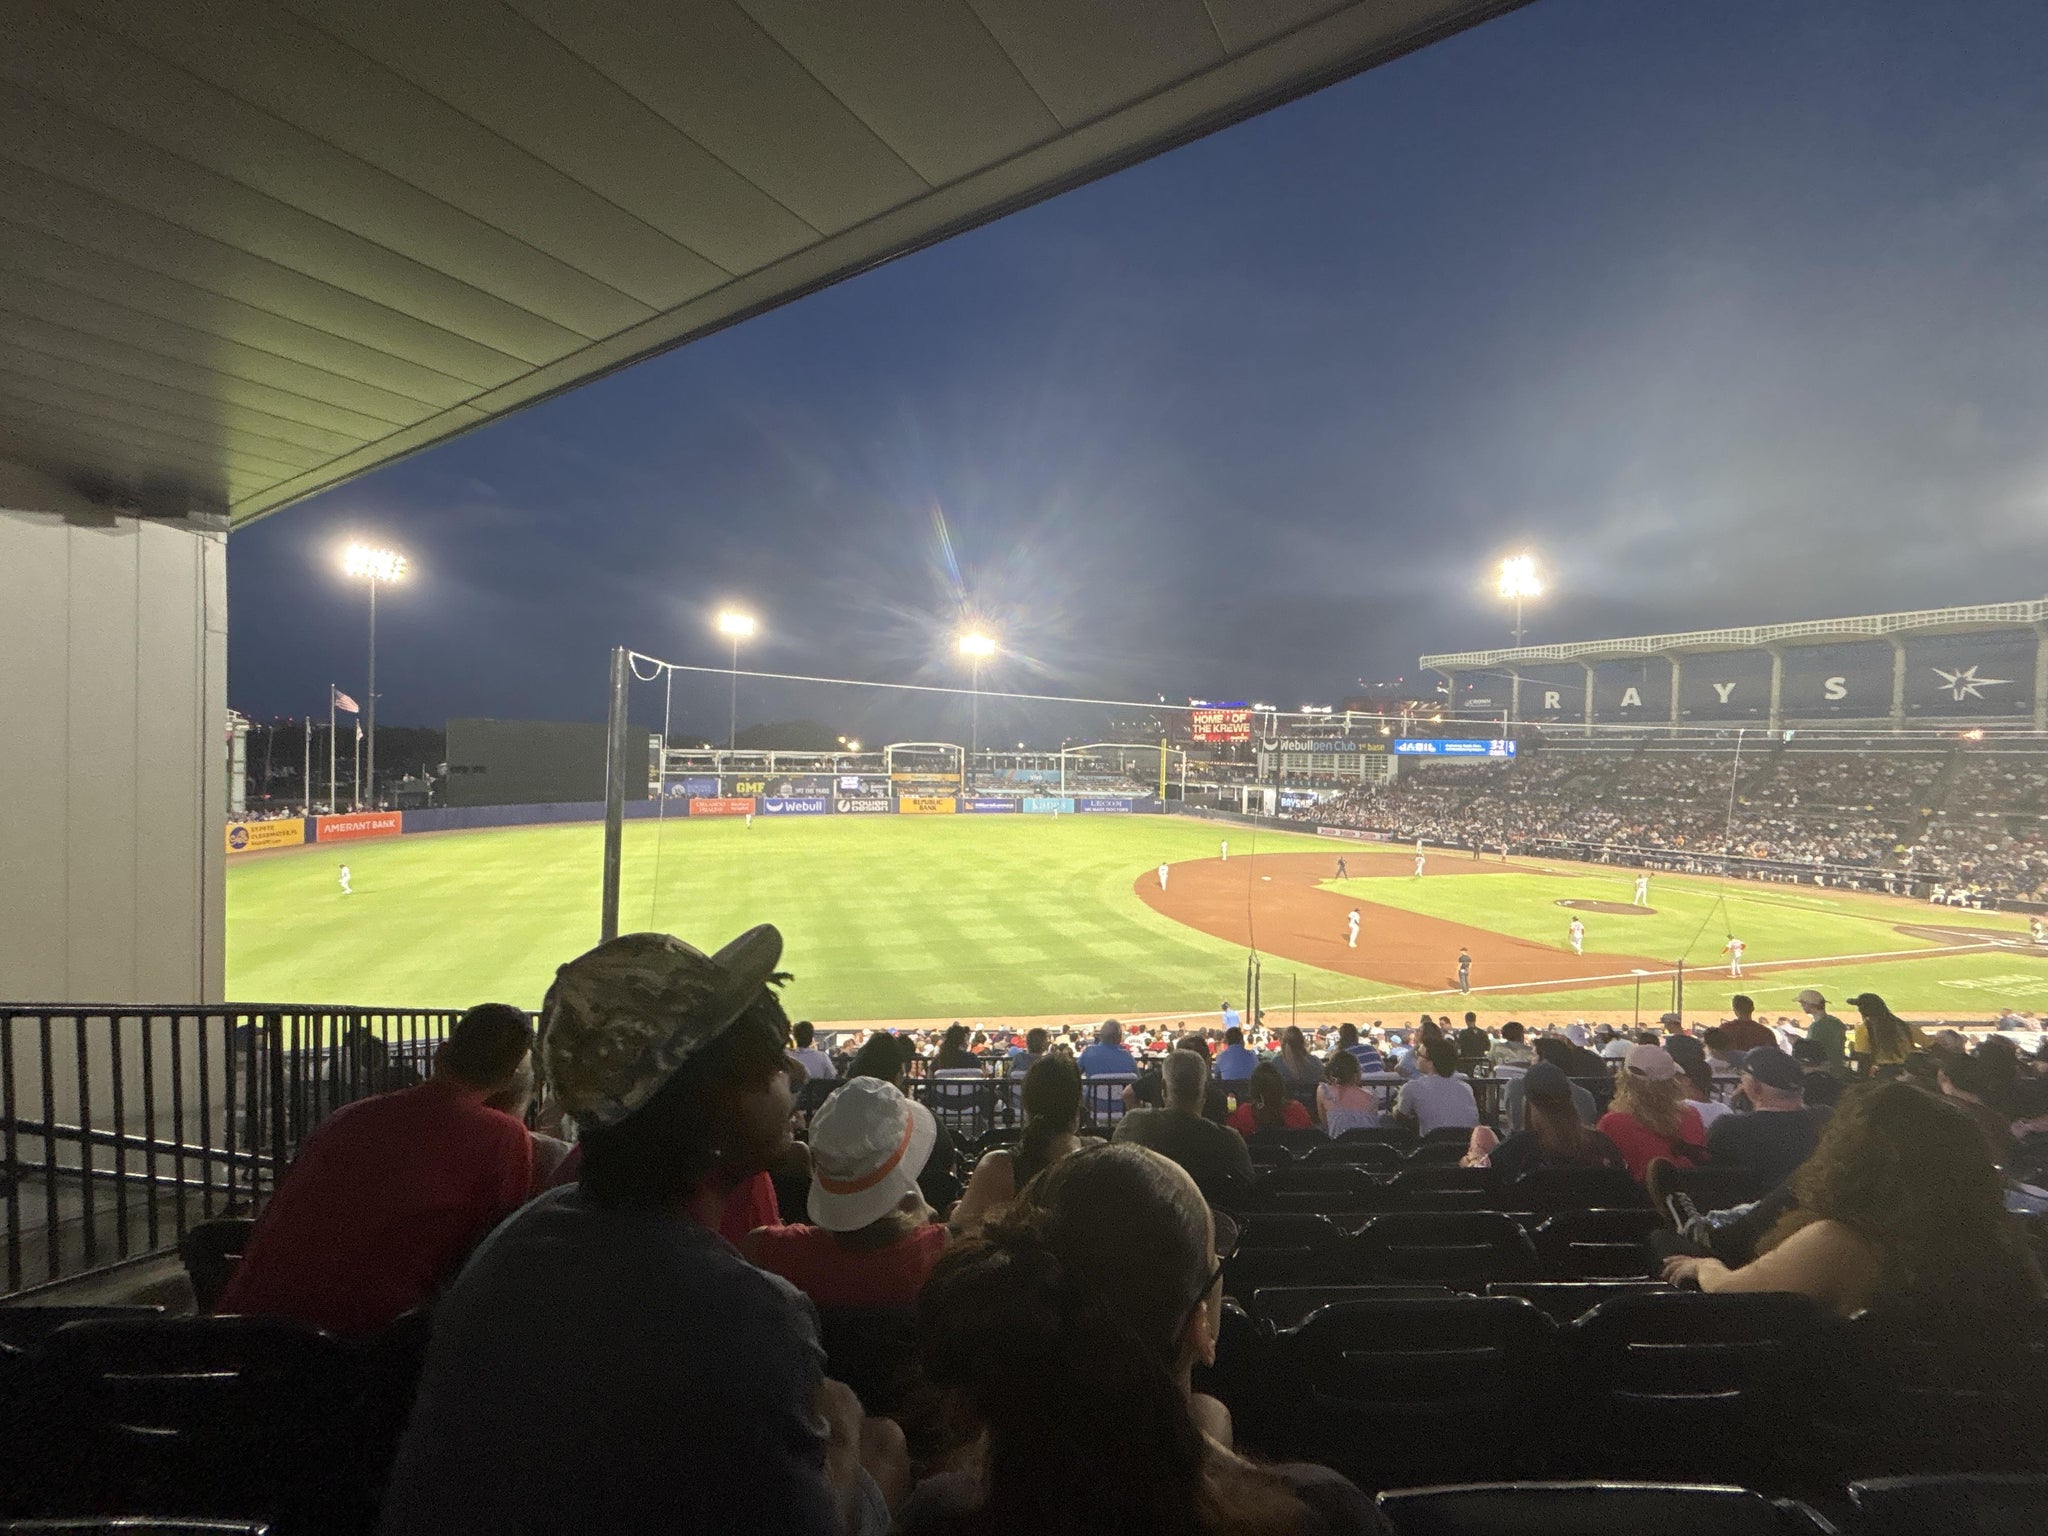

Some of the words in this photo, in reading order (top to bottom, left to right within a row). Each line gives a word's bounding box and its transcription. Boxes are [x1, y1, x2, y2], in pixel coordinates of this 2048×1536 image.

[1193, 714, 1223, 724] HOME
[1231, 713, 1247, 723] OF
[1192, 724, 1211, 733] THE
[1212, 723, 1250, 733] KREWE
[1334, 741, 1356, 751] Club
[1367, 743, 1385, 751] base
[785, 801, 822, 811] Webull
[324, 821, 371, 833] AMERANT
[372, 819, 396, 829] BANK
